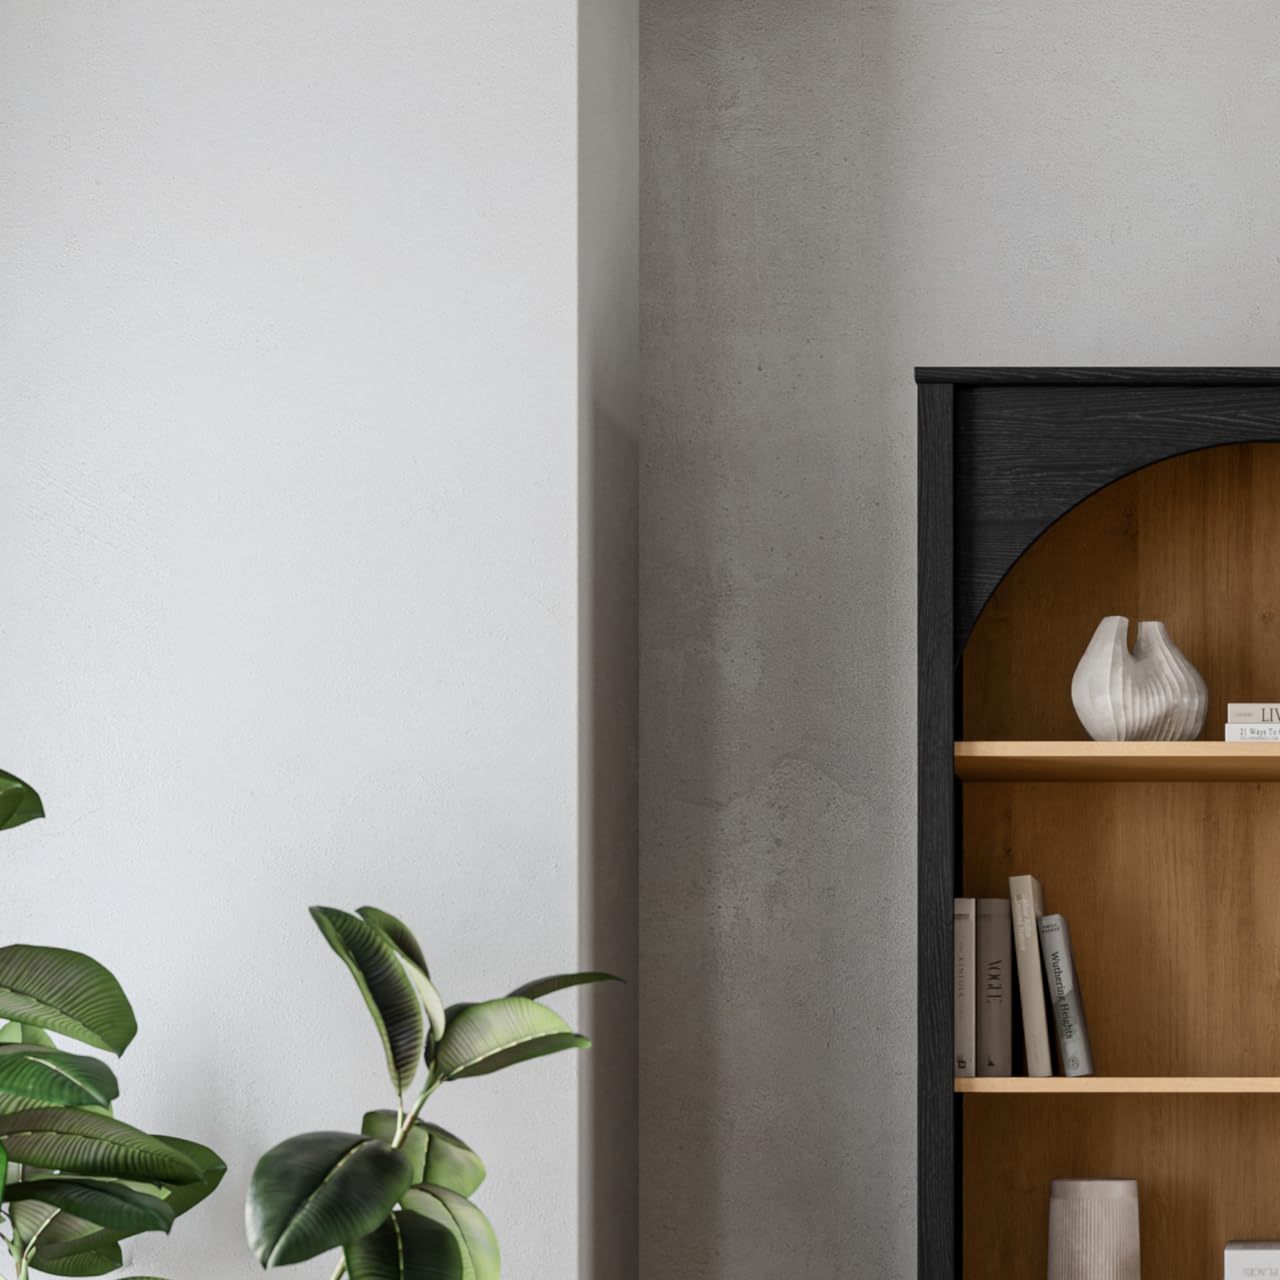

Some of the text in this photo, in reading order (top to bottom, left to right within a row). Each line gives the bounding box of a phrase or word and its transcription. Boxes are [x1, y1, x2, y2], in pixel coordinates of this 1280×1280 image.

[1249, 728, 1267, 738] Ways
[1268, 728, 1277, 736] To
[1050, 950, 1066, 1002] Wuthering
[1057, 1002, 1074, 1040] Heights
